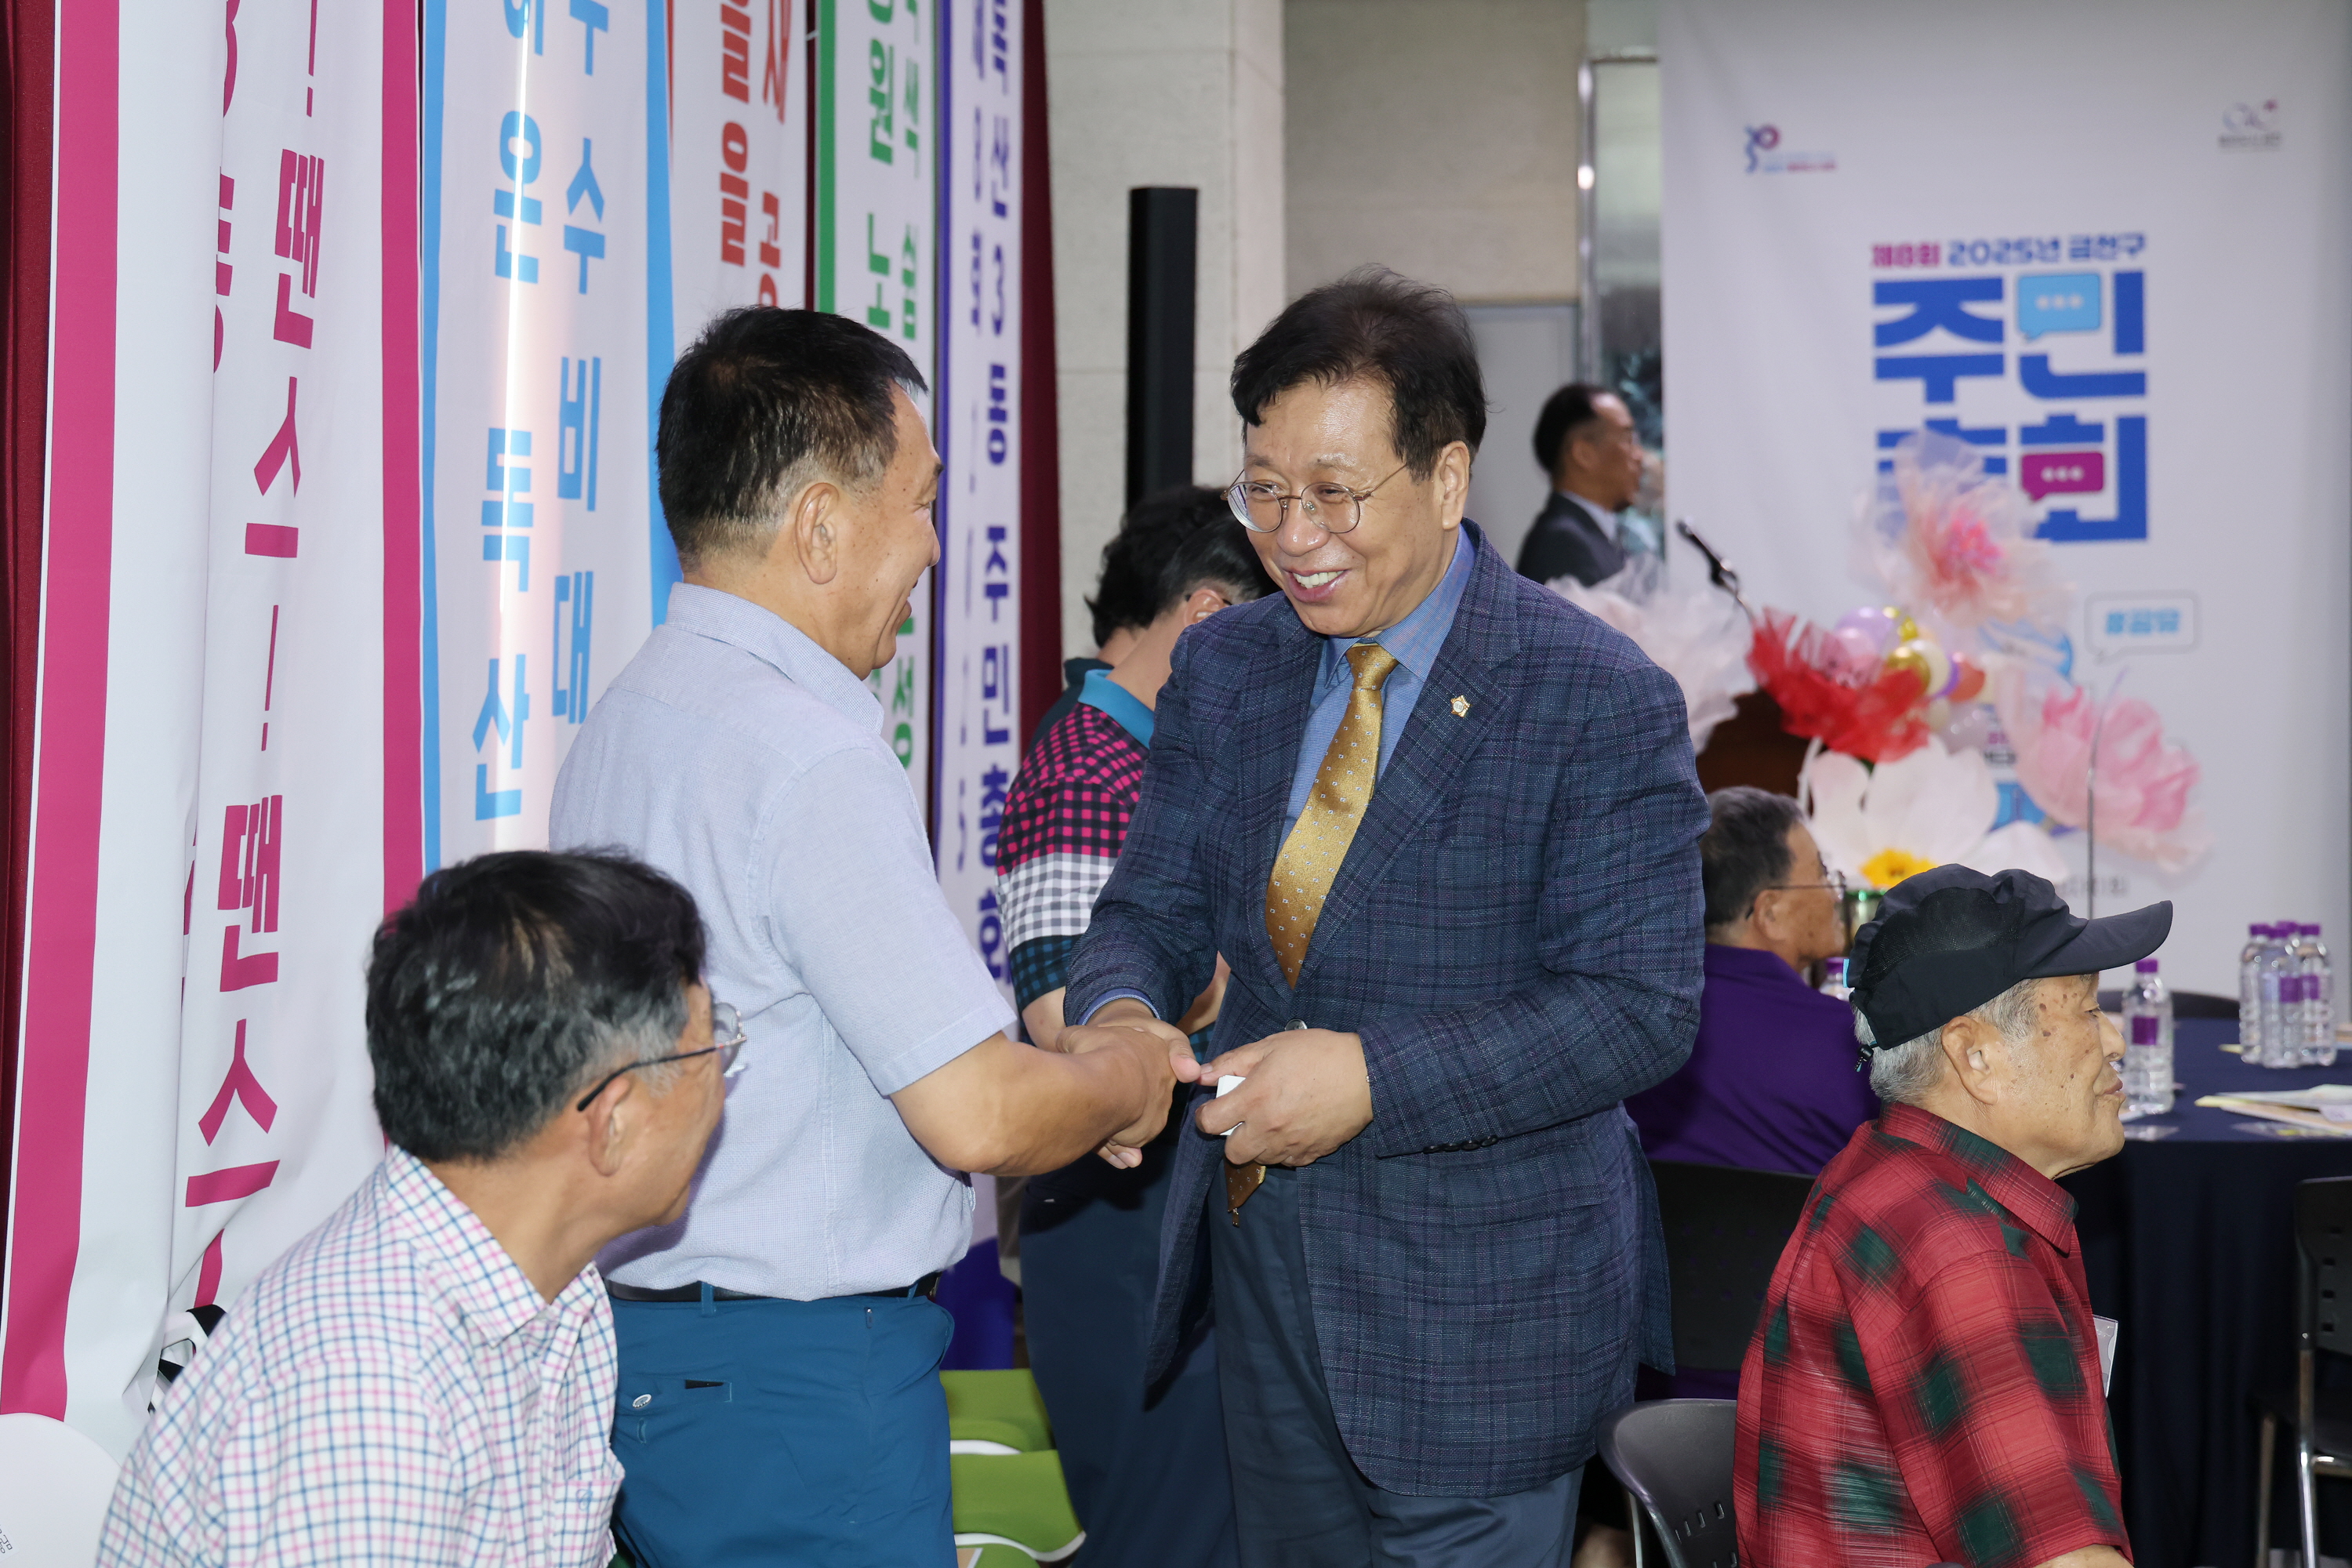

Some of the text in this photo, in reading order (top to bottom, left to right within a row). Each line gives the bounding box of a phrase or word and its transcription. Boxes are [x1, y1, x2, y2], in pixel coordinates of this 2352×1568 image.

[1949, 238, 2059, 267] 2025년
[2068, 232, 2145, 261] 금천구
[472, 427, 534, 821] 독산
